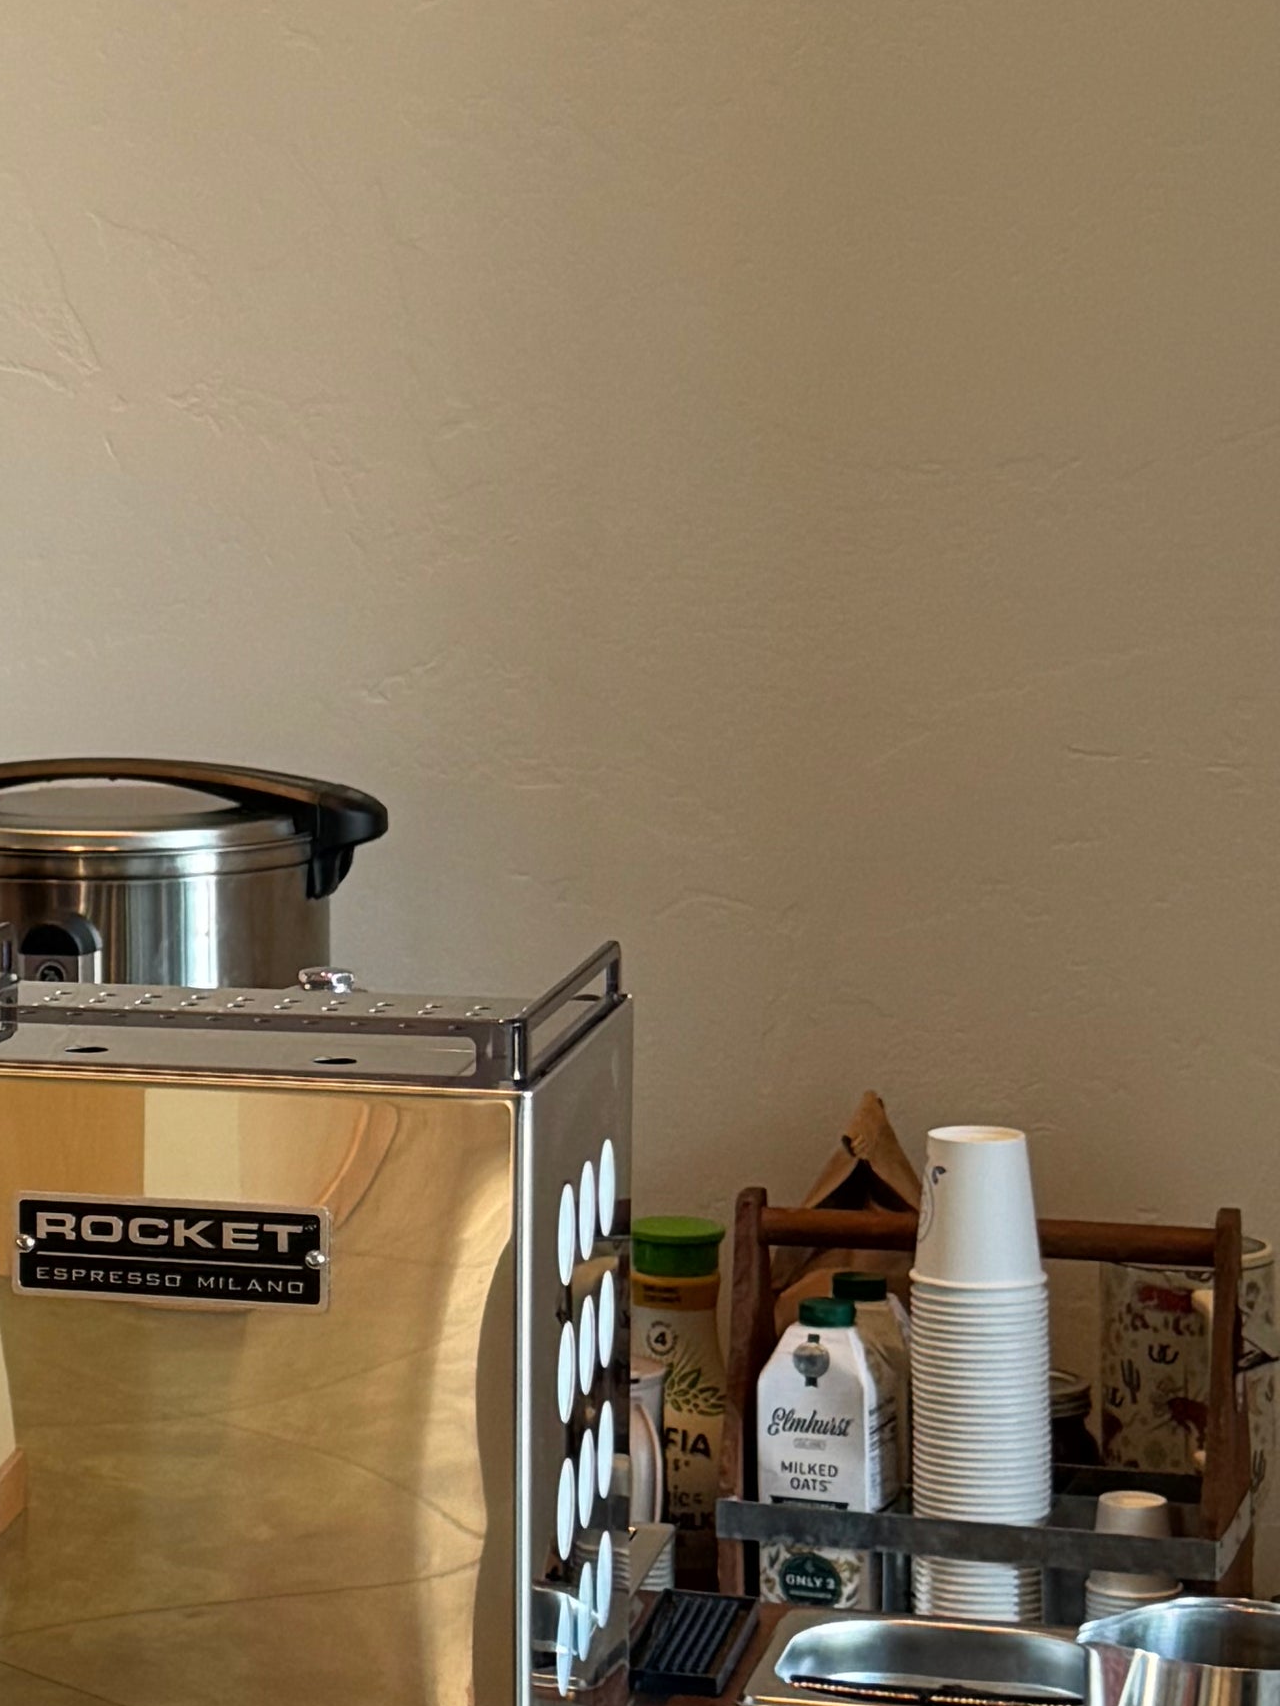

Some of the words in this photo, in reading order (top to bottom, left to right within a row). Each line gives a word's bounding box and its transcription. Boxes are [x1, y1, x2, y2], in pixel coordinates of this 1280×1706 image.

[36, 1211, 304, 1253] ROCKET
[36, 1266, 182, 1288] ESPRESSO
[198, 1276, 304, 1294] MILANO
[767, 1406, 854, 1437] Elmhurst
[780, 1460, 838, 1478] MILKED
[790, 1477, 829, 1493] OATS
[785, 1573, 823, 1588] ONLY
